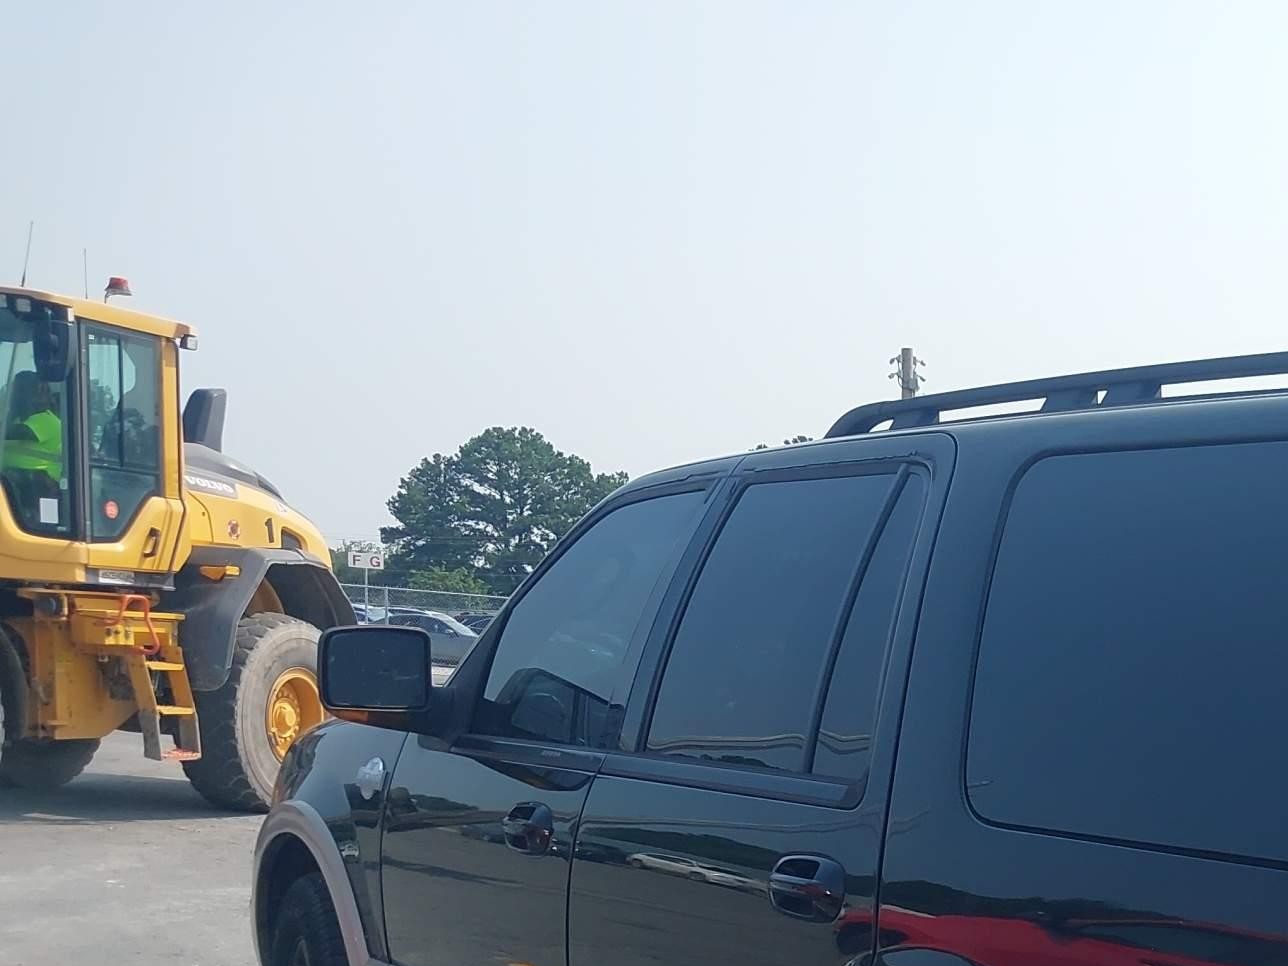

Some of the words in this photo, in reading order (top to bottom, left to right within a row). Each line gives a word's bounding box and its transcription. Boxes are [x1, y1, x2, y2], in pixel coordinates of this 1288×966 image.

[184, 475, 234, 494] VOLVO
[265, 518, 274, 543] 1
[352, 554, 361, 566] F
[370, 556, 381, 568] G
